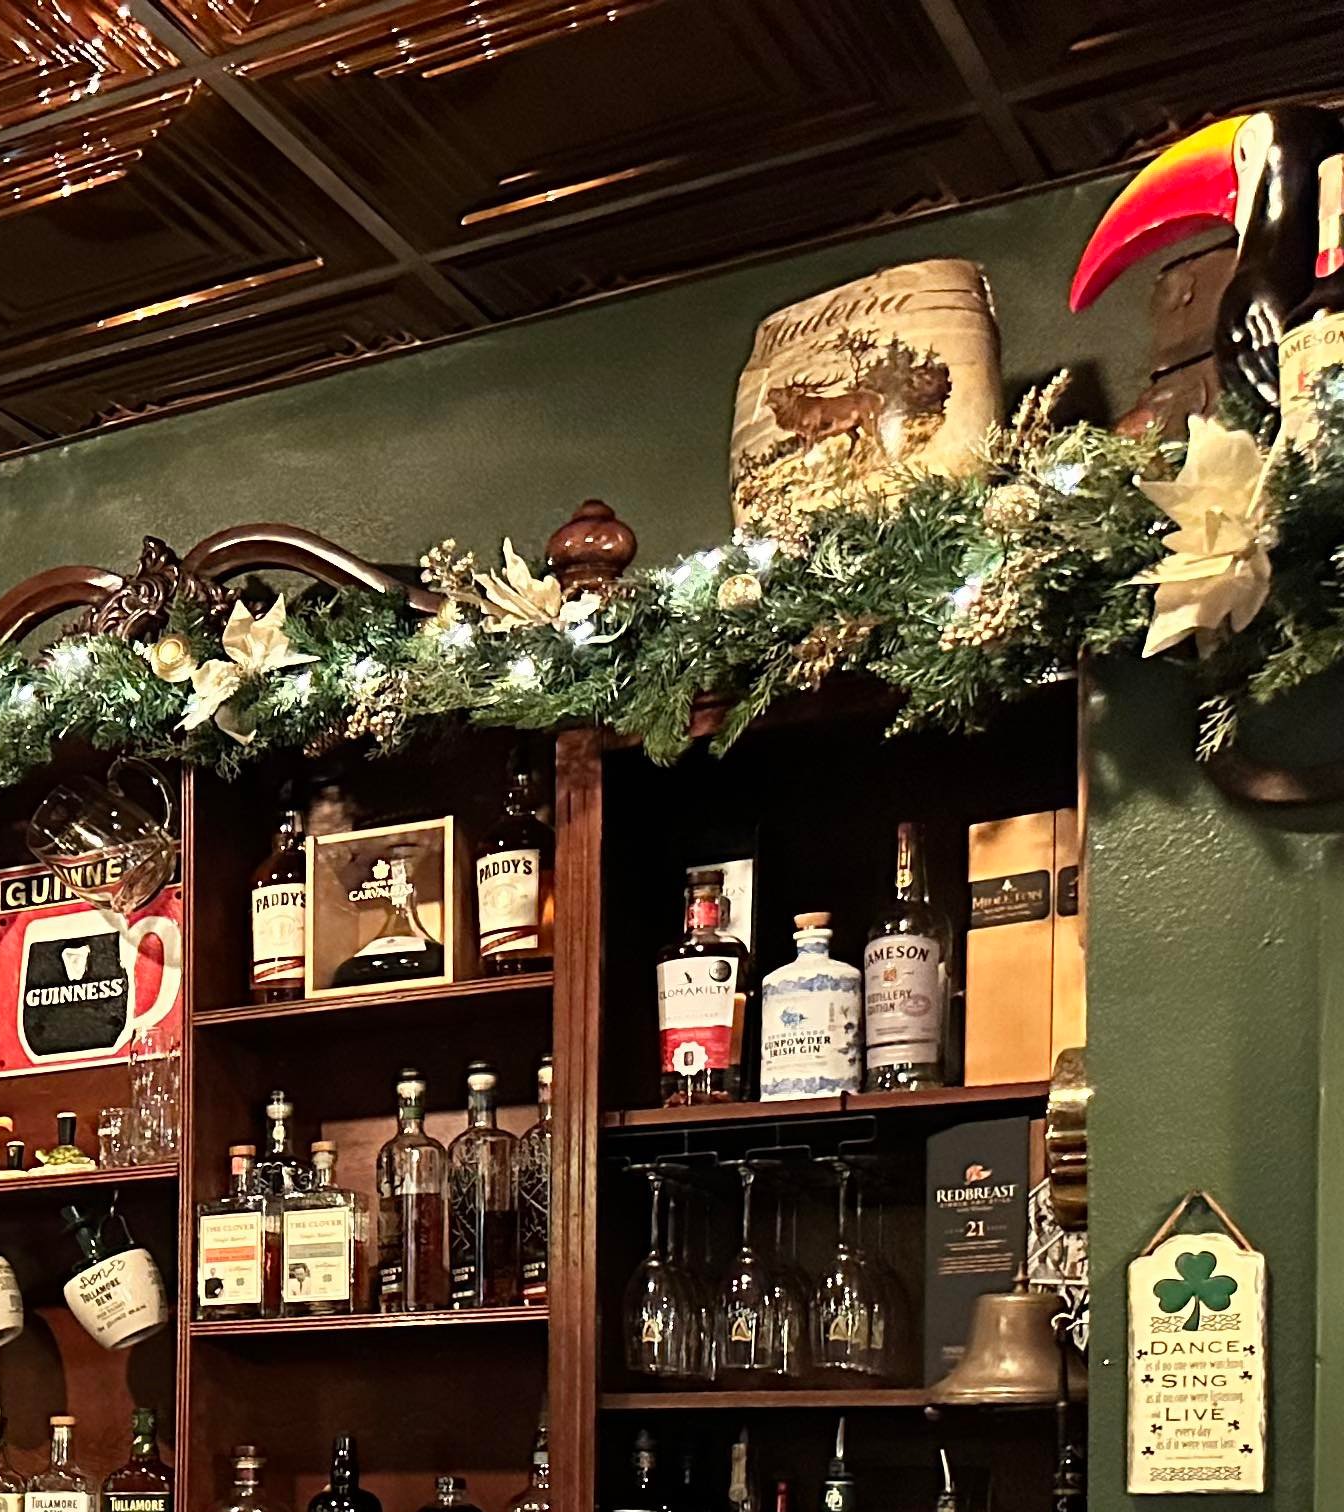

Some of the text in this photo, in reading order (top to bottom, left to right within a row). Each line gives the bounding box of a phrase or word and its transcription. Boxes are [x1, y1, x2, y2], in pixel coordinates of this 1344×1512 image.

[763, 286, 914, 355] Madeira
[478, 856, 533, 884] PADDY'S
[26, 978, 124, 1007] GUINNESS
[764, 1036, 831, 1050] GUNPOWDER
[770, 1045, 821, 1057] IRISH GIN
[936, 1184, 1017, 1204] REDBREAST
[966, 1221, 985, 1237] 21
[1150, 1340, 1240, 1356] DANCE
[1161, 1374, 1228, 1389] SING
[1165, 1407, 1225, 1422] LIVE
[32, 1497, 78, 1510] TULLAMORE
[110, 1497, 165, 1512] TULLAMORE
